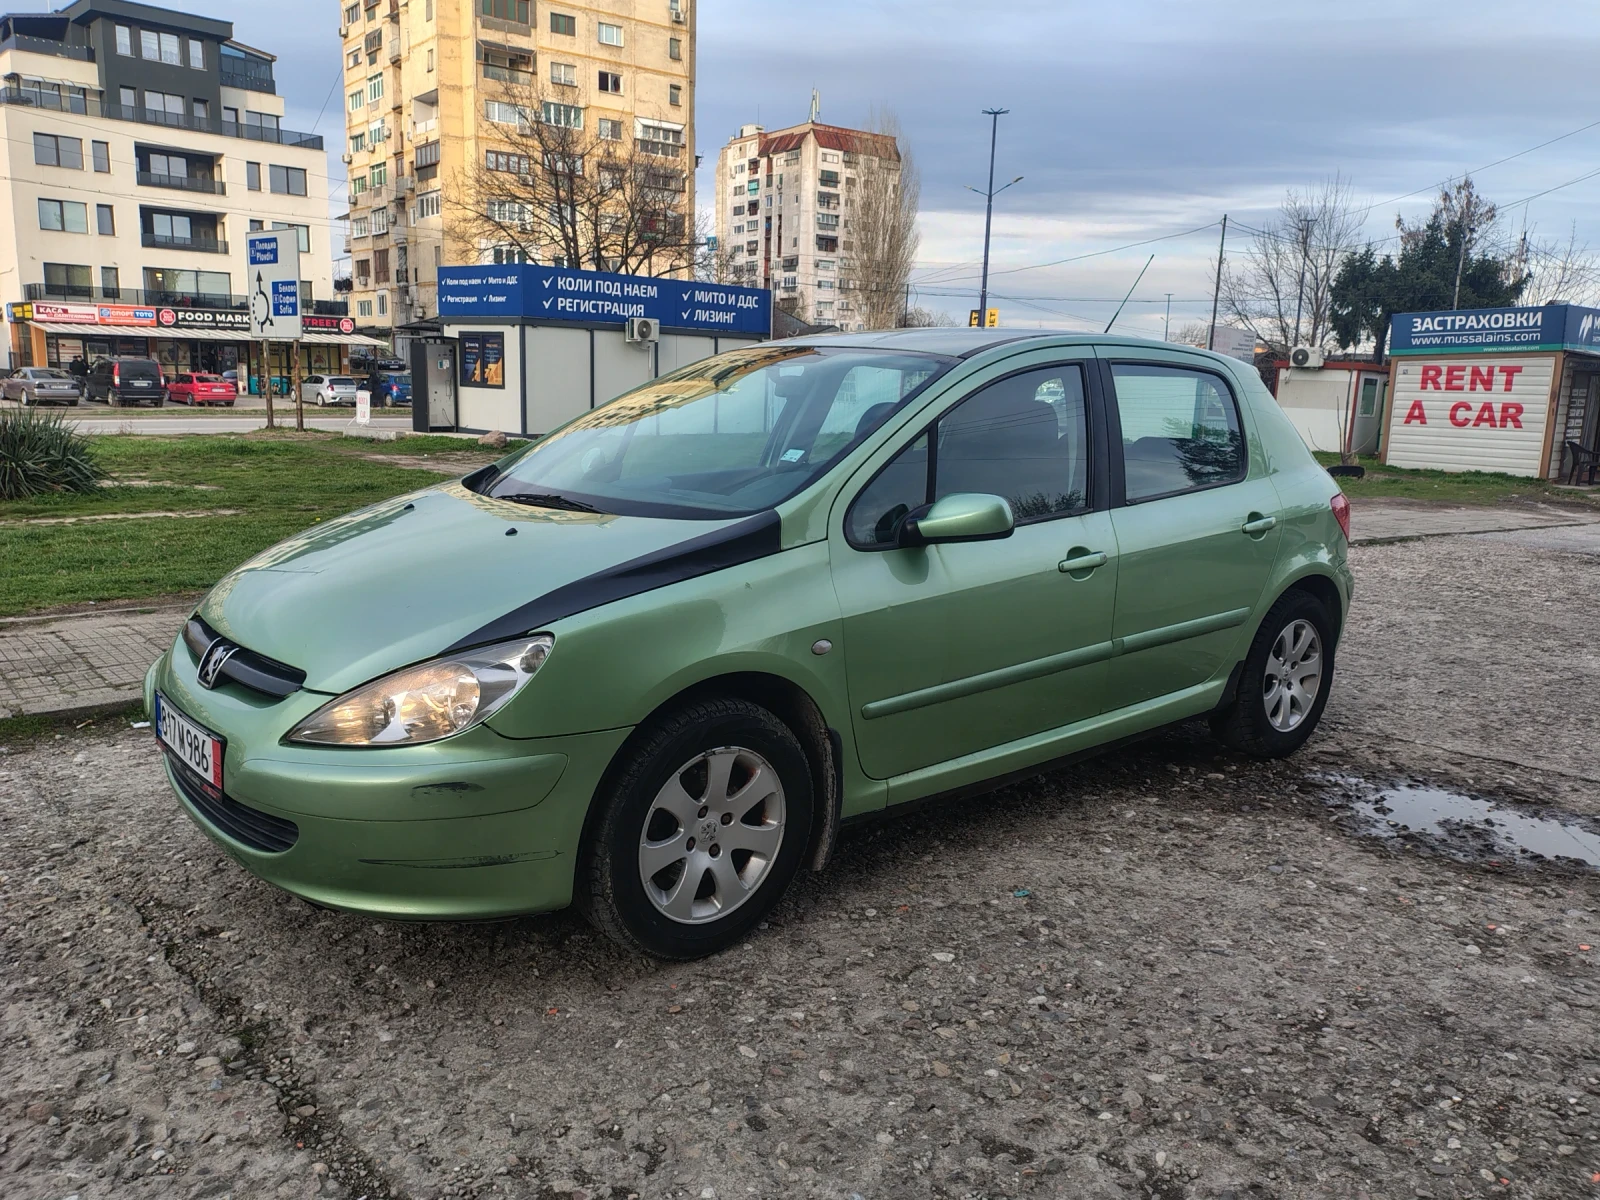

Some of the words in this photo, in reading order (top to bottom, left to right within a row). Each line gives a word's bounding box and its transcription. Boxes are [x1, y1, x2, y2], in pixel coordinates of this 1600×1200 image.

[255, 241, 277, 250] Пловдив
[256, 252, 274, 261] Plovdiv
[446, 278, 459, 286] Коли
[488, 276, 502, 285] Мито
[506, 276, 518, 286] ДДС
[278, 283, 296, 293] Белово
[557, 276, 593, 293] КОЛИ
[595, 280, 622, 298] ПОД
[623, 283, 658, 299] НАЕМ
[279, 294, 296, 304] София
[694, 290, 726, 305] МИТО
[728, 293, 736, 306] И
[737, 294, 759, 309] ДДС
[39, 306, 64, 314] КАСА
[279, 305, 293, 314] Sofia
[557, 297, 645, 318] РЕГИСТРАЦИЯ
[177, 311, 213, 321] FOOD
[215, 313, 250, 323] MARK
[693, 309, 737, 324] ЛИЗИНГ
[1411, 311, 1543, 332] ЗАСТРАХОВКИ
[1411, 332, 1541, 346] www.mussalains.com
[1419, 365, 1524, 392] RENT
[1403, 400, 1428, 425] A
[1448, 401, 1525, 429] CAR
